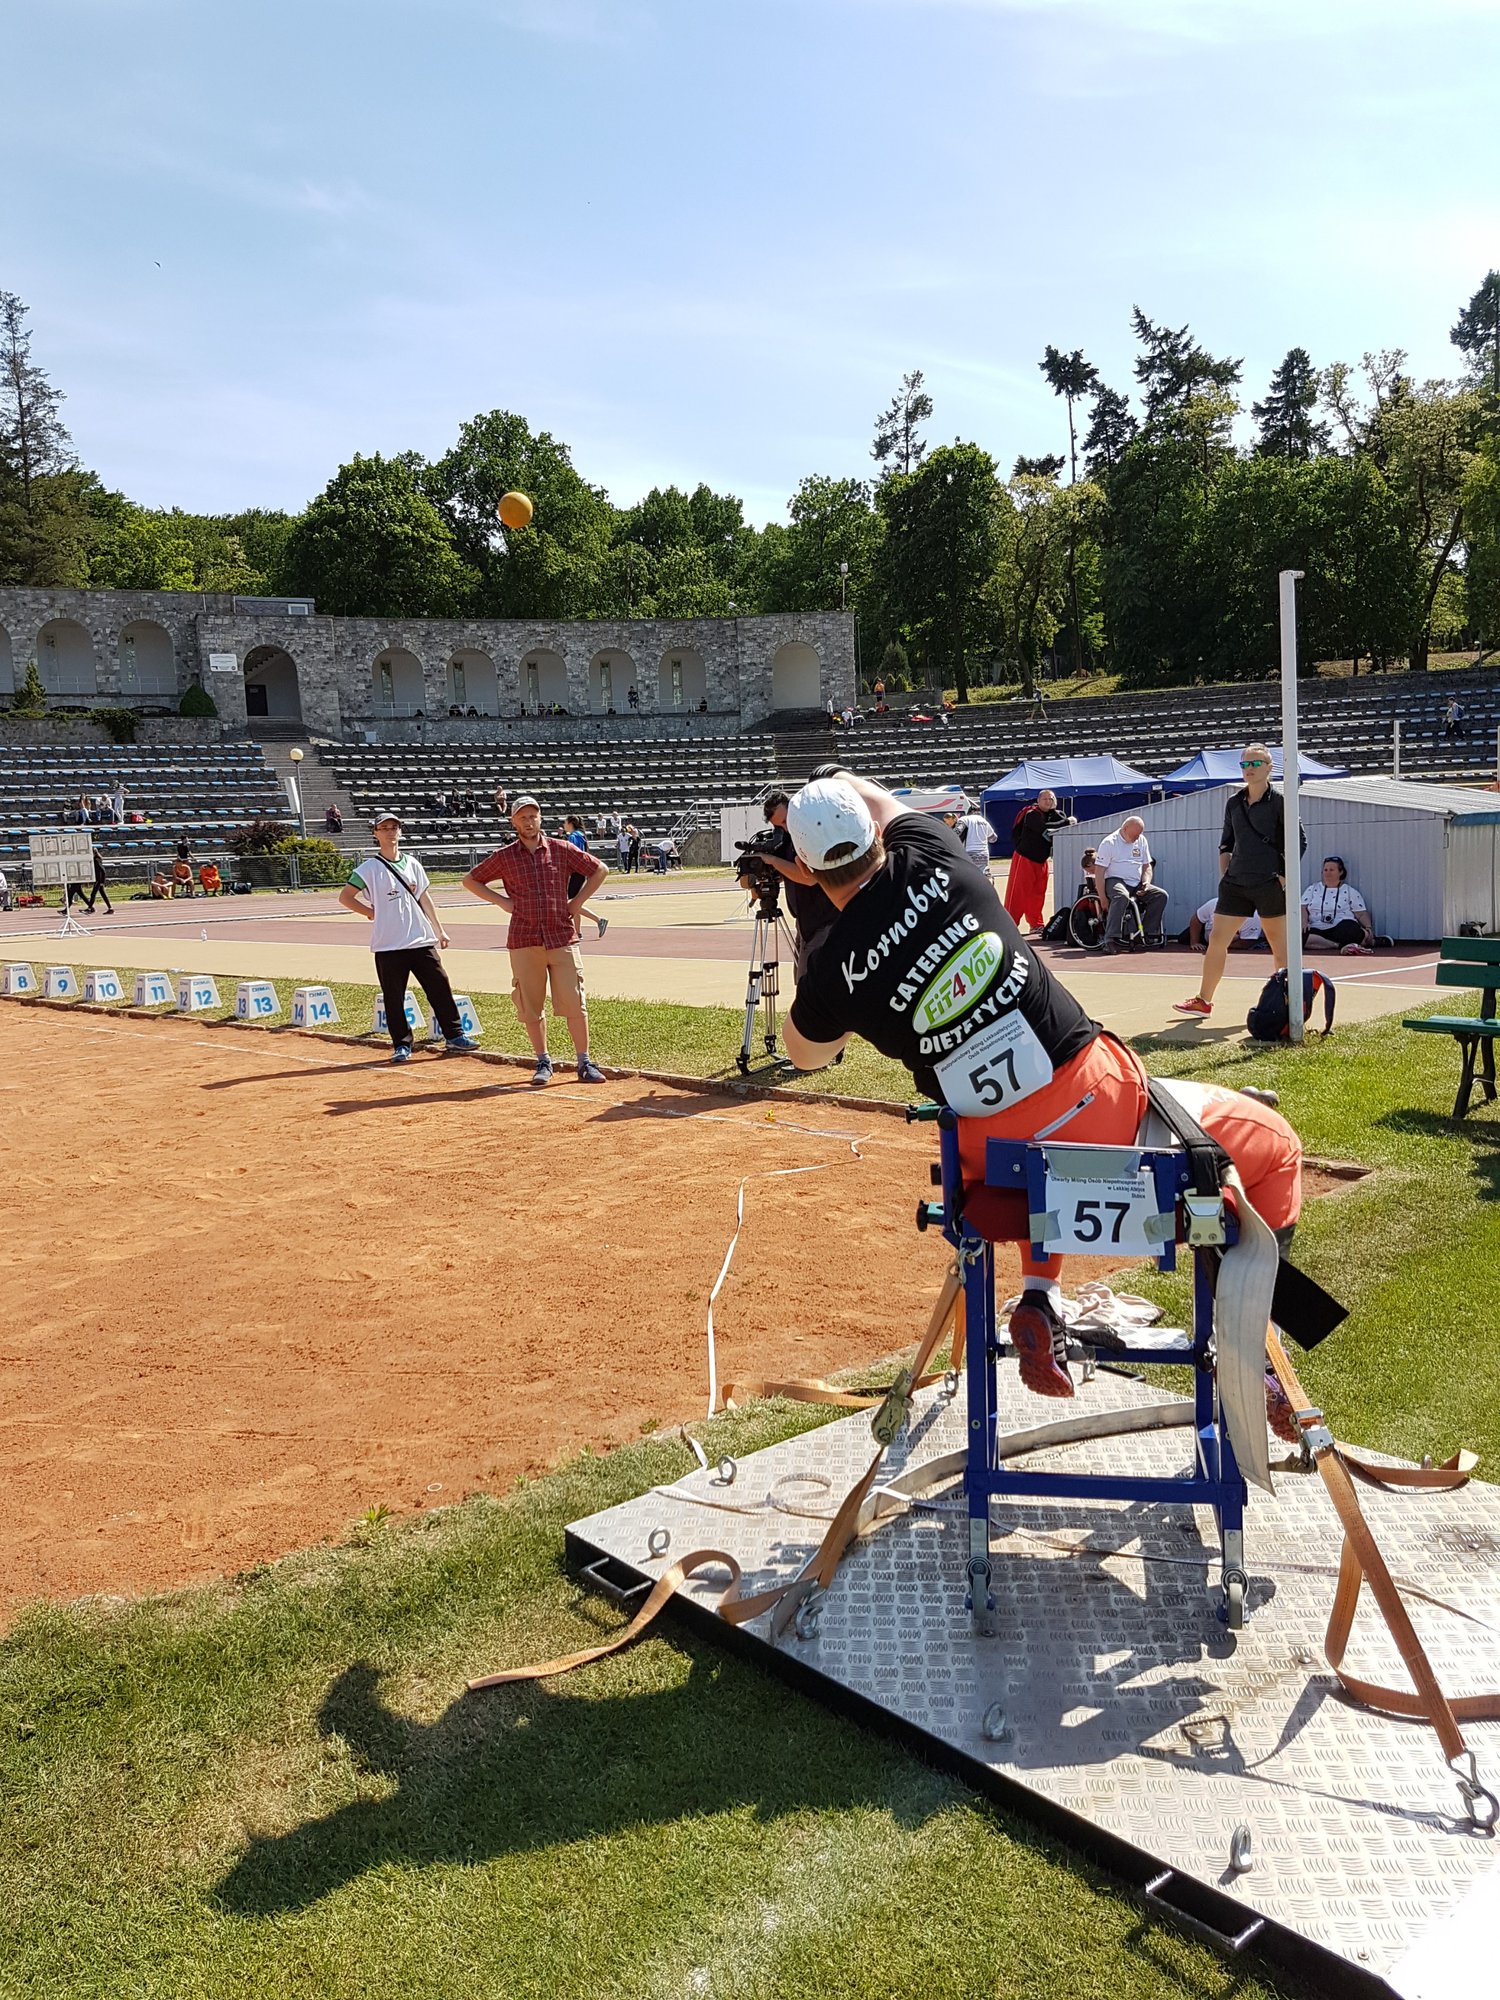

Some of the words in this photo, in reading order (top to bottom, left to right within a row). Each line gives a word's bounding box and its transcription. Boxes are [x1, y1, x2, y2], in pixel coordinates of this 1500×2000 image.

[841, 868, 950, 994] Kornobys
[889, 913, 980, 1012] CATERING
[17, 976, 28, 988] 8
[57, 979, 68, 992] 9
[98, 982, 117, 998] 10
[85, 984, 93, 998] 10
[151, 986, 166, 1001] 11
[180, 991, 188, 1006] 12
[195, 989, 213, 1006] 12
[238, 998, 246, 1014] 13
[254, 996, 273, 1013] 13
[294, 1003, 304, 1021] 14
[310, 1002, 331, 1020] 14
[968, 1047, 1021, 1106] 57
[1073, 1200, 1131, 1243] 57
